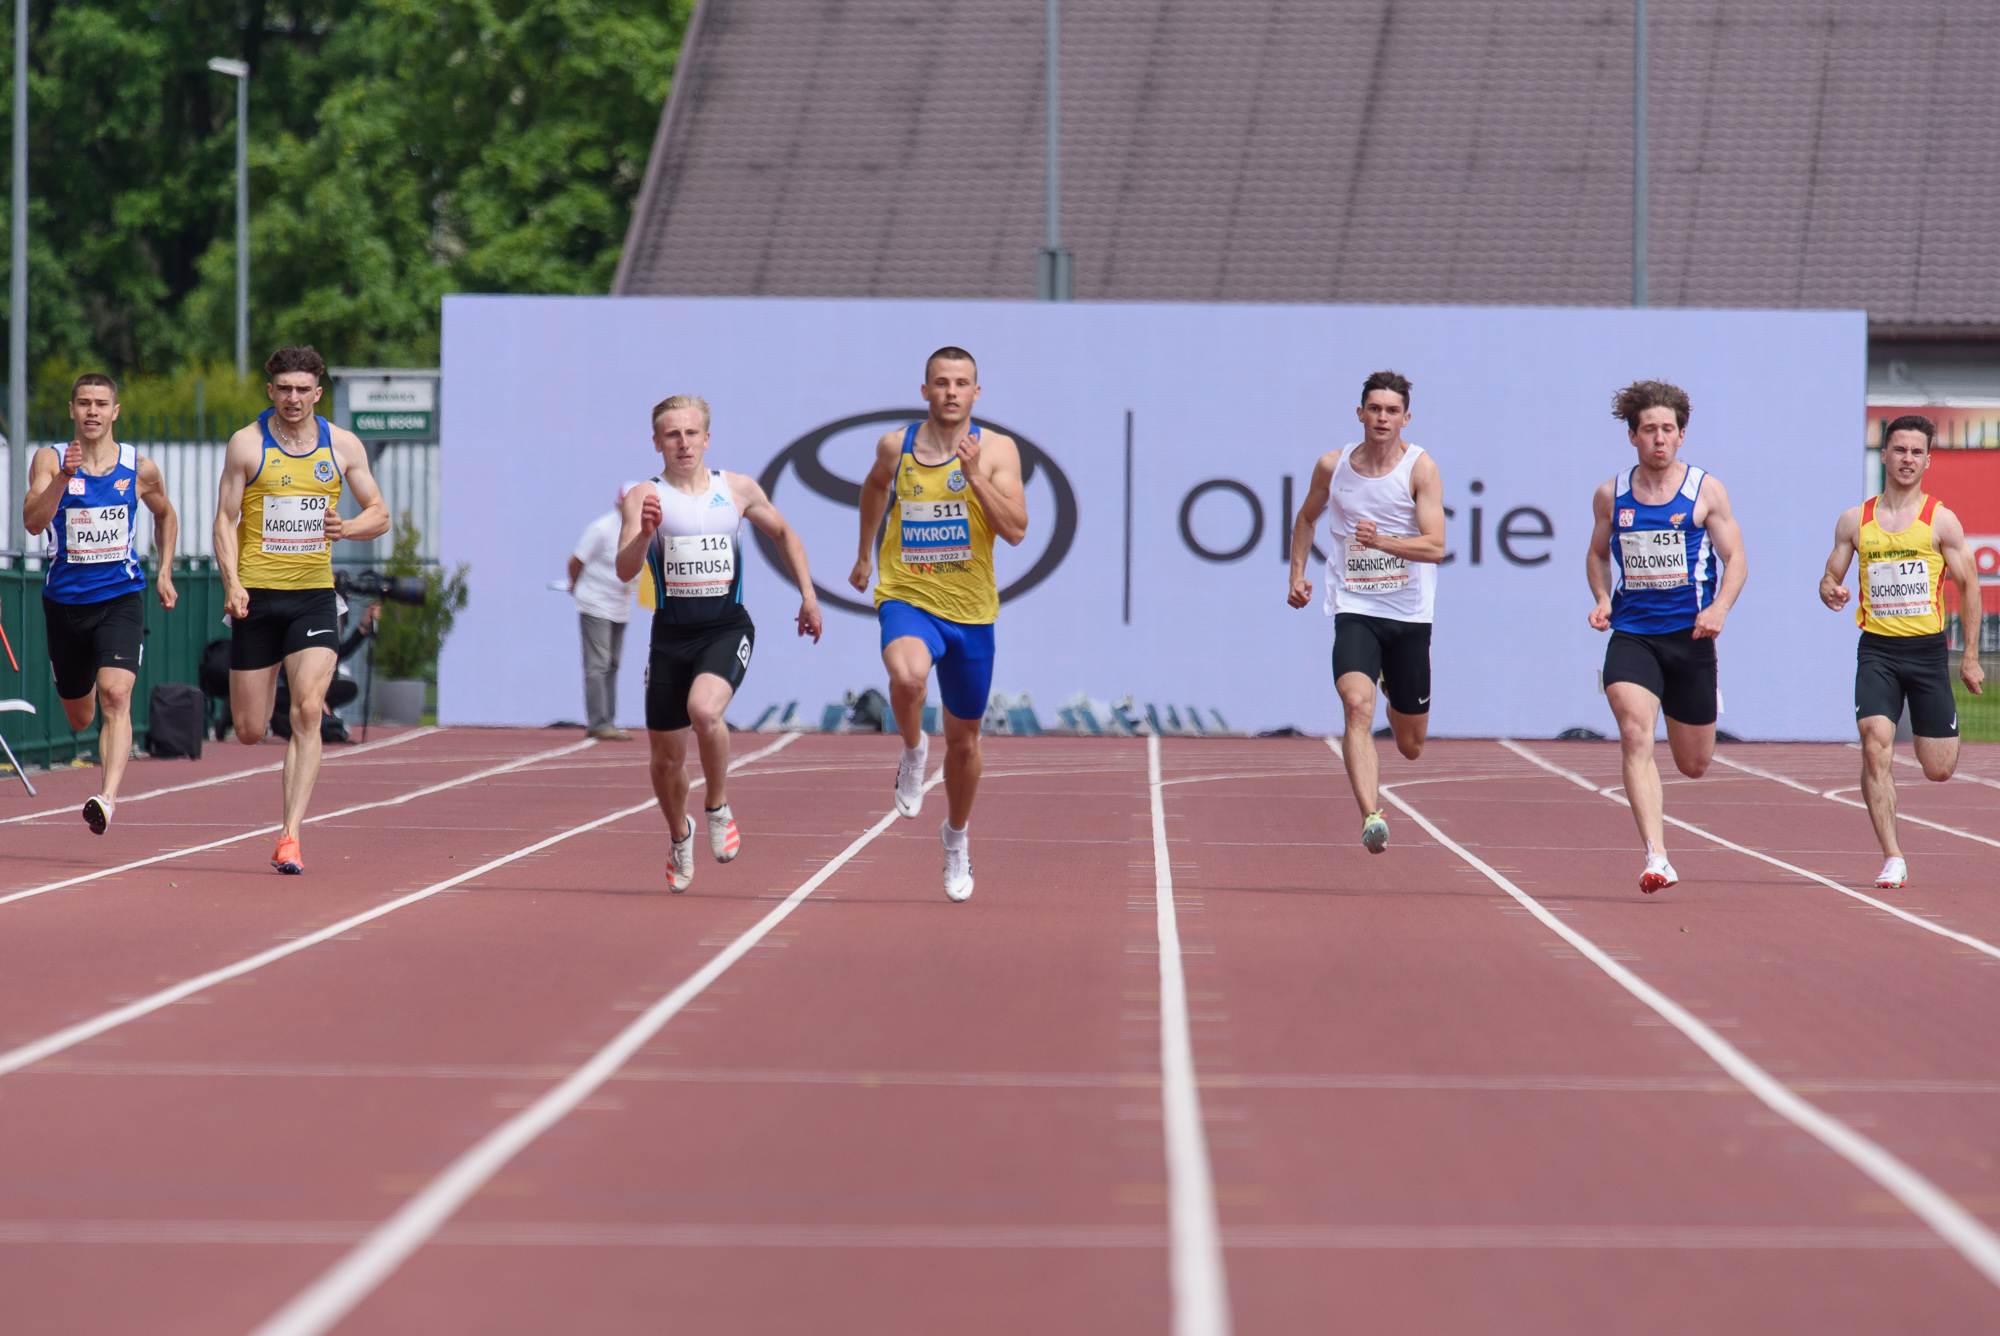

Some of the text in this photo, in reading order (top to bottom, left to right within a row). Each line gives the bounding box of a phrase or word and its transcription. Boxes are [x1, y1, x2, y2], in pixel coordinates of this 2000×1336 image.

[300, 498, 326, 511] 503
[933, 503, 963, 518] 511
[99, 507, 126, 521] 456
[1180, 476, 1555, 566] Okie
[77, 529, 119, 544] PAJĄK
[902, 525, 967, 542] WYKROTA
[1653, 532, 1681, 546] 451
[265, 544, 317, 552] SUWAŁKI 2022
[700, 537, 728, 552] 116
[70, 552, 120, 562] SUWAŁKI 2022
[904, 552, 959, 562] SUWAŁKI 2022
[1624, 553, 1684, 569] KOZŁOWSKI
[1868, 548, 1918, 560] AKL URSYNÓW
[666, 559, 731, 576] PIETRUSA
[1347, 556, 1405, 572] SZACHNIEWICZ
[1899, 561, 1925, 576] 171
[669, 586, 724, 596] SUWAŁKI 2022
[1658, 580, 1677, 588] 2022
[1870, 581, 1928, 598] SUCHOROWSKI
[1904, 607, 1921, 615] 2022
[740, 643, 750, 661] 6
